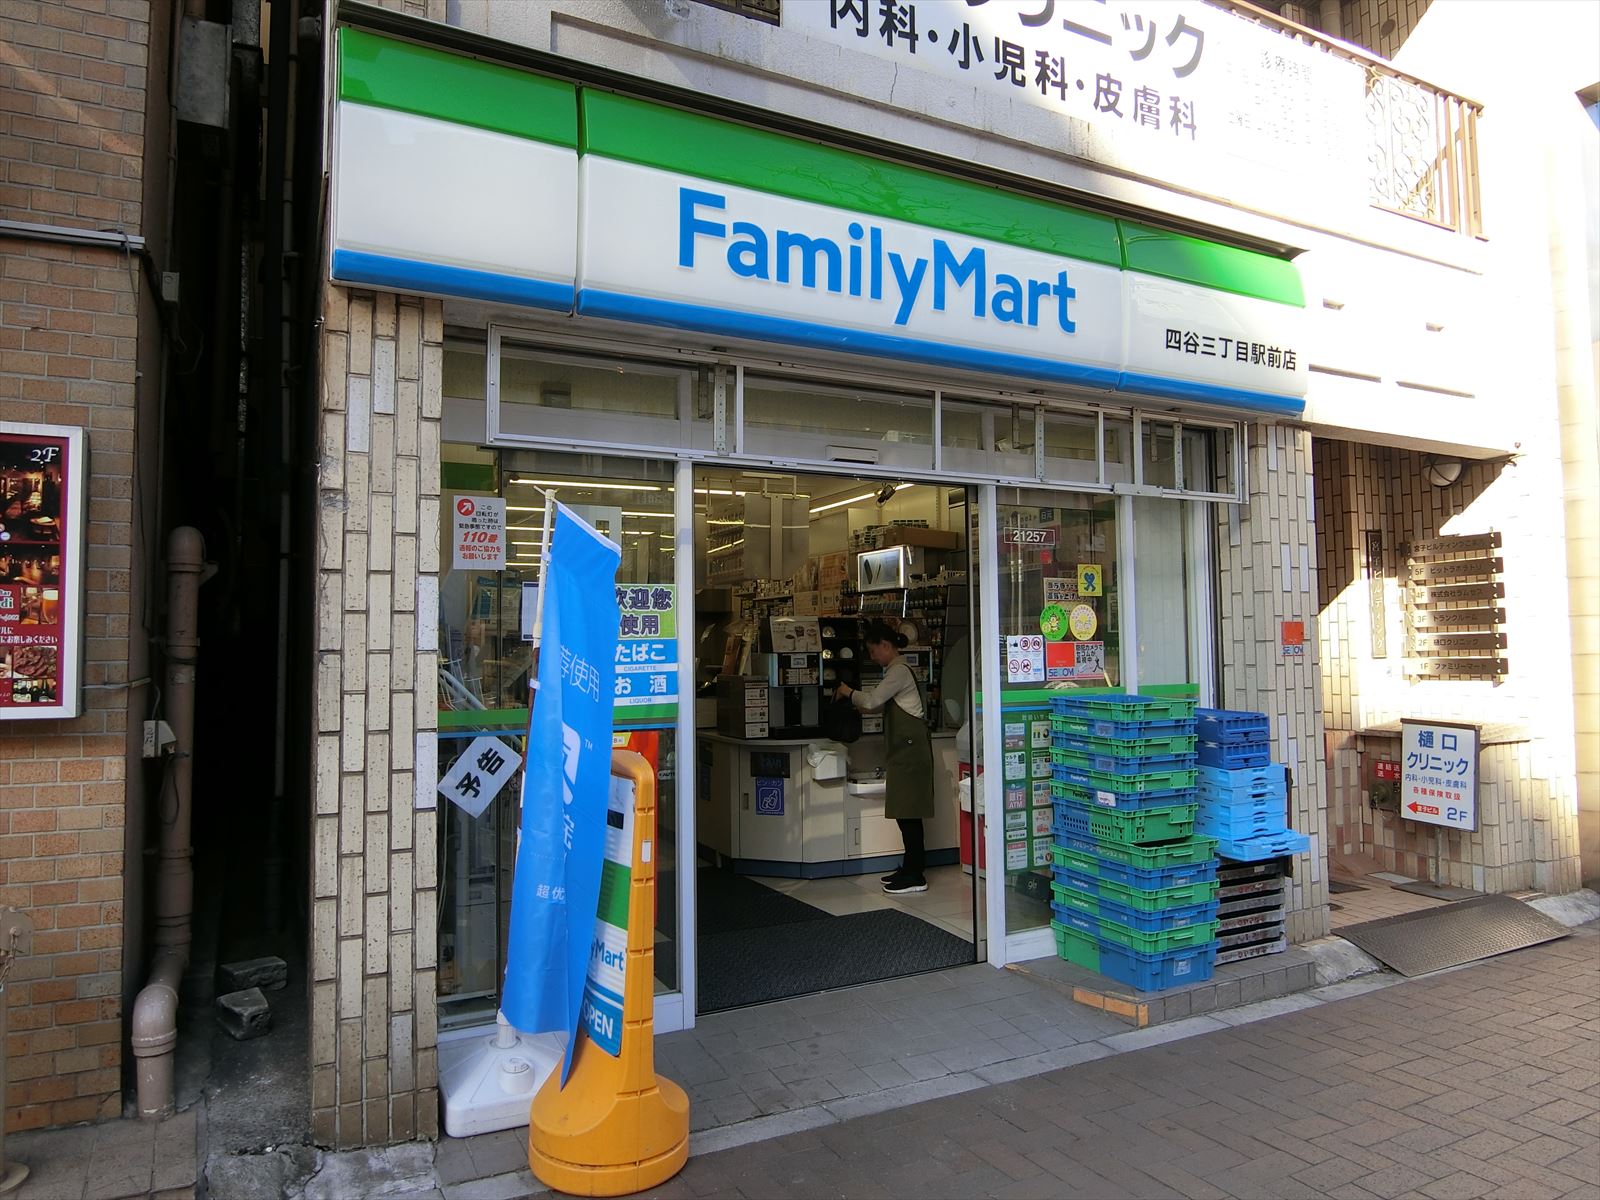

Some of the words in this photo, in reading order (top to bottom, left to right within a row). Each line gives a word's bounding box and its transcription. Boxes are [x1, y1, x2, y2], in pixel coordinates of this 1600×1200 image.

[677, 185, 1077, 335] FamilyMart
[1165, 328, 1297, 372] 四谷三丁目駅前店
[30, 446, 60, 462] 2F
[463, 531, 498, 543] 110番
[1012, 530, 1047, 543] 21257
[619, 614, 660, 635] 使用
[614, 643, 666, 663] たばこ
[1282, 645, 1304, 654] SEOM
[1048, 668, 1075, 677] SEOM
[1434, 662, 1487, 670] ファミリーマート
[1418, 730, 1458, 752] 樋口
[1407, 751, 1469, 776] クリニック
[455, 747, 505, 798] 予告
[1405, 773, 1467, 789] 内科・小児科・皮膚科
[1413, 786, 1461, 801] 各種保険取扱
[1009, 801, 1023, 809] ATM
[1446, 807, 1468, 822] 2F
[583, 998, 614, 1040] OPEN
